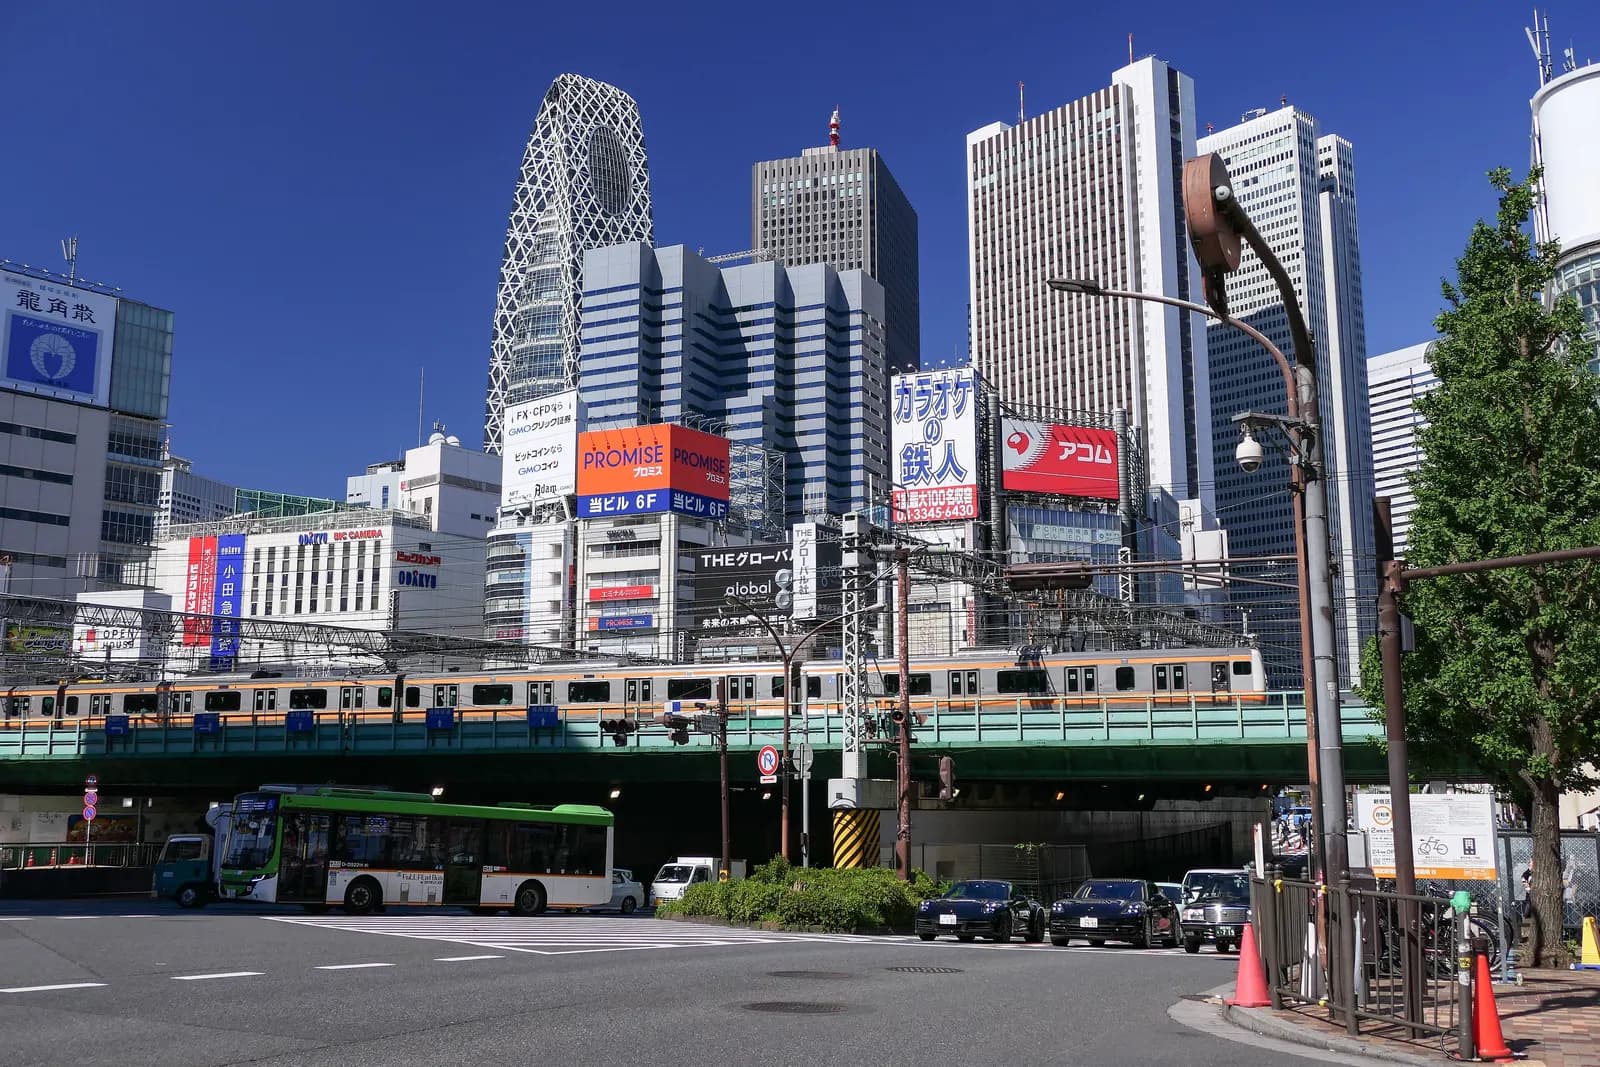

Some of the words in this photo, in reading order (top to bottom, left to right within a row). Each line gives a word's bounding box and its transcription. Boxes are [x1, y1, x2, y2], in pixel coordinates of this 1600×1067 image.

[17, 289, 96, 324] 龍角散
[894, 371, 973, 423] カラオケ
[508, 414, 571, 437] GMOクリック証券
[923, 416, 942, 446] の
[515, 444, 563, 462] ビットコインなら
[584, 444, 664, 470] PROMISE
[673, 447, 725, 474] PROMISE
[900, 439, 967, 487] 鉄人
[1058, 441, 1112, 464] アコム
[518, 460, 559, 476] GMOコイン
[633, 465, 663, 479] プロミス
[706, 472, 725, 485] プロミス
[589, 498, 629, 513] 当ビル
[636, 494, 657, 510] 6F
[673, 493, 704, 512] 当ビル
[709, 503, 725, 516] 6F
[334, 532, 347, 541] BIC
[348, 529, 383, 540] CAMERA
[103, 629, 135, 640] OPEN
[103, 640, 135, 649] HOUSE
